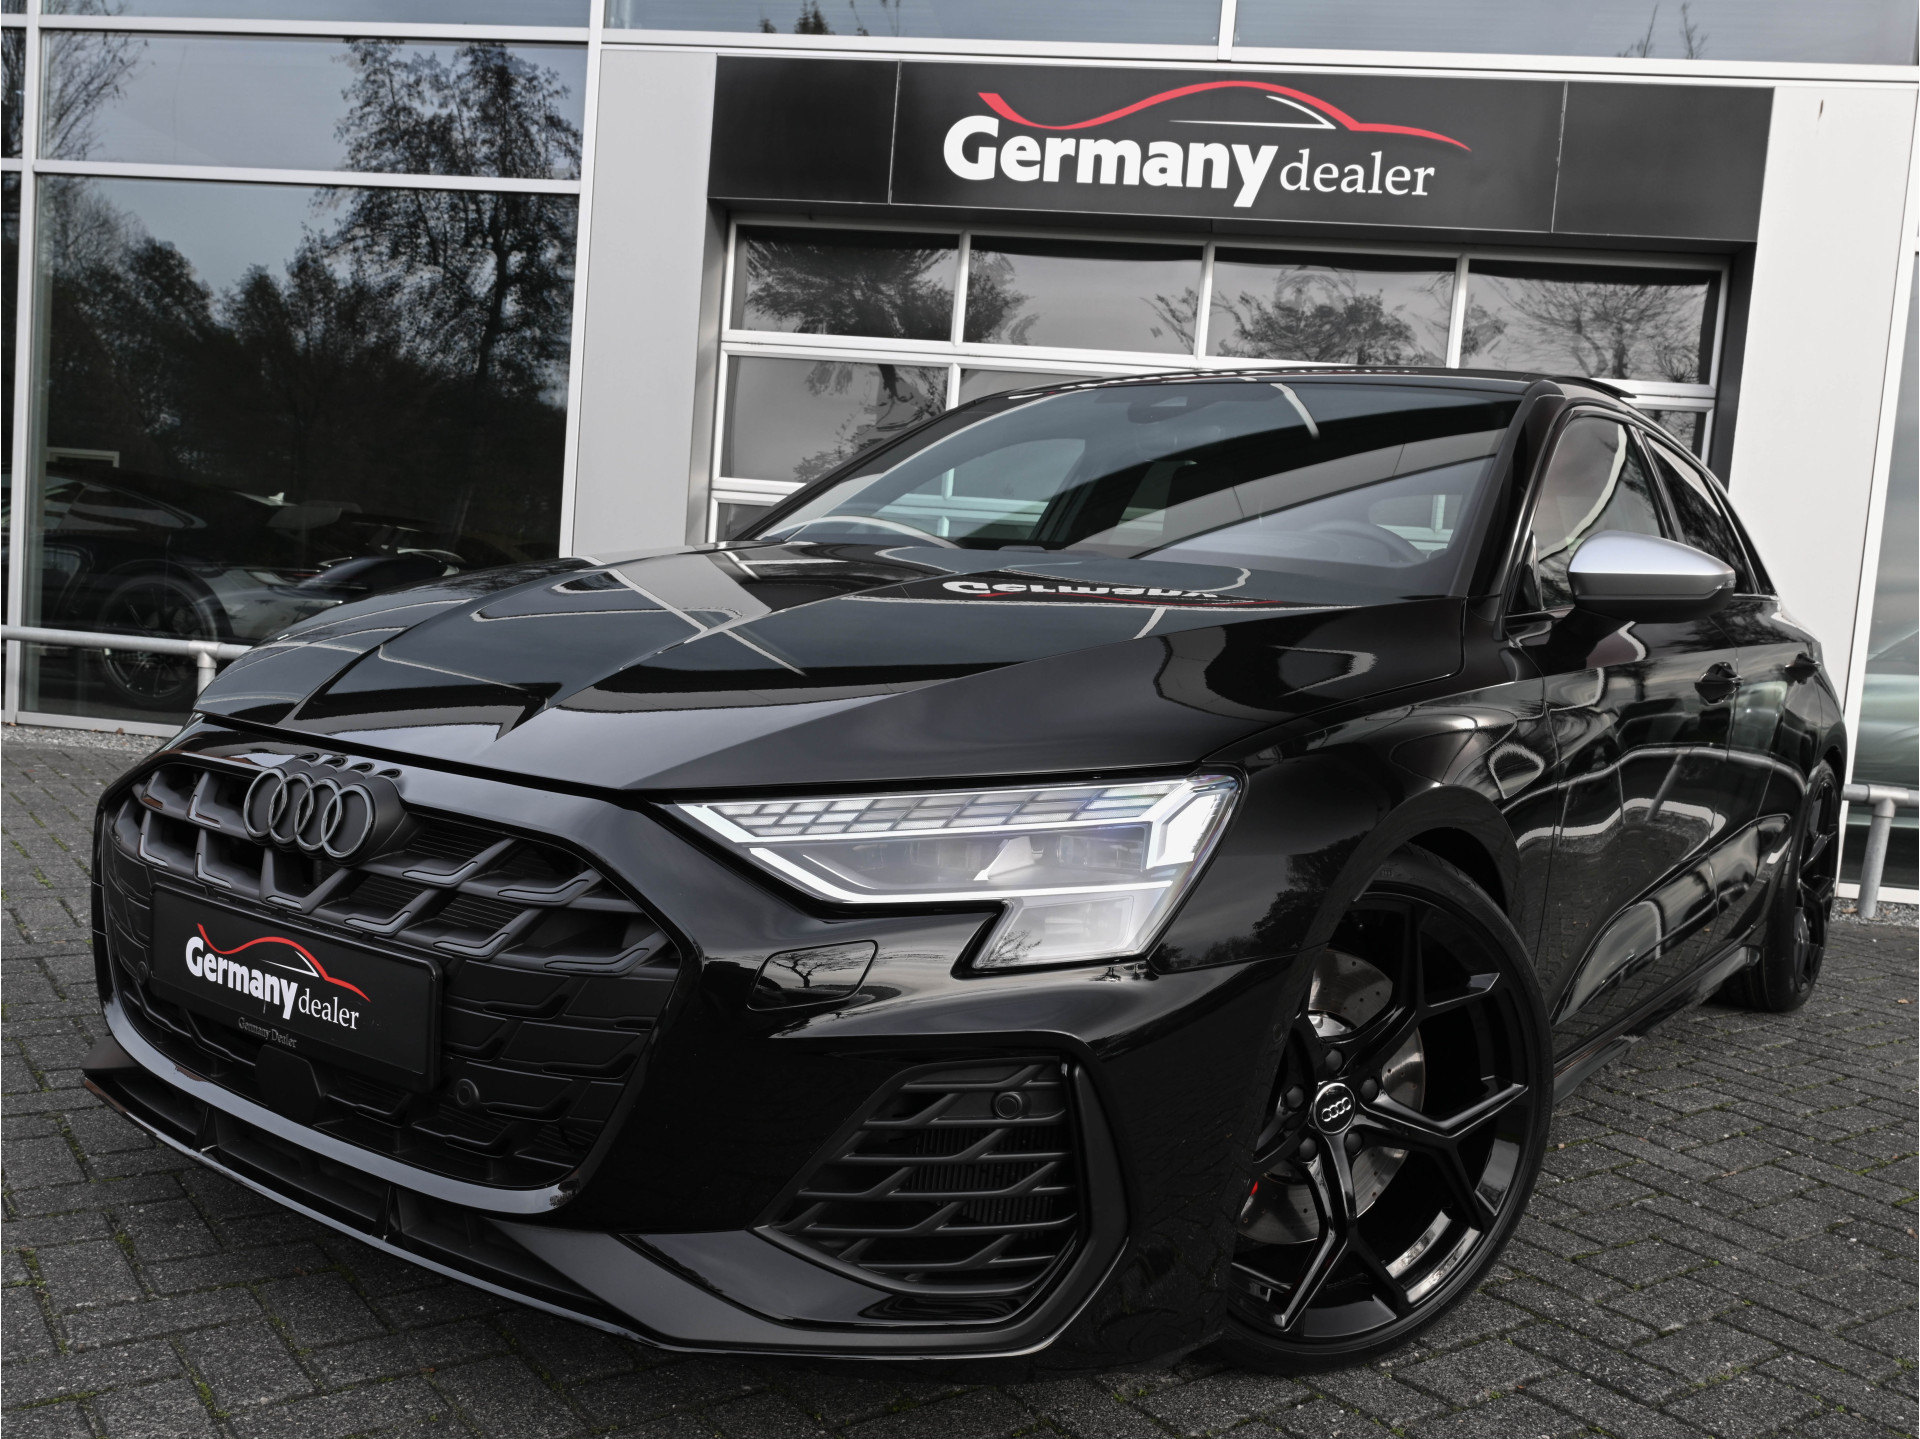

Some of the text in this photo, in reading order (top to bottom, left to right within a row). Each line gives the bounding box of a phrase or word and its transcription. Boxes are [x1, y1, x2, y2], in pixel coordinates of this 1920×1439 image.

[943, 115, 1435, 207] Germany dealer
[186, 936, 359, 1029] Germany dealer
[238, 1016, 297, 1048] Germany Dealer
